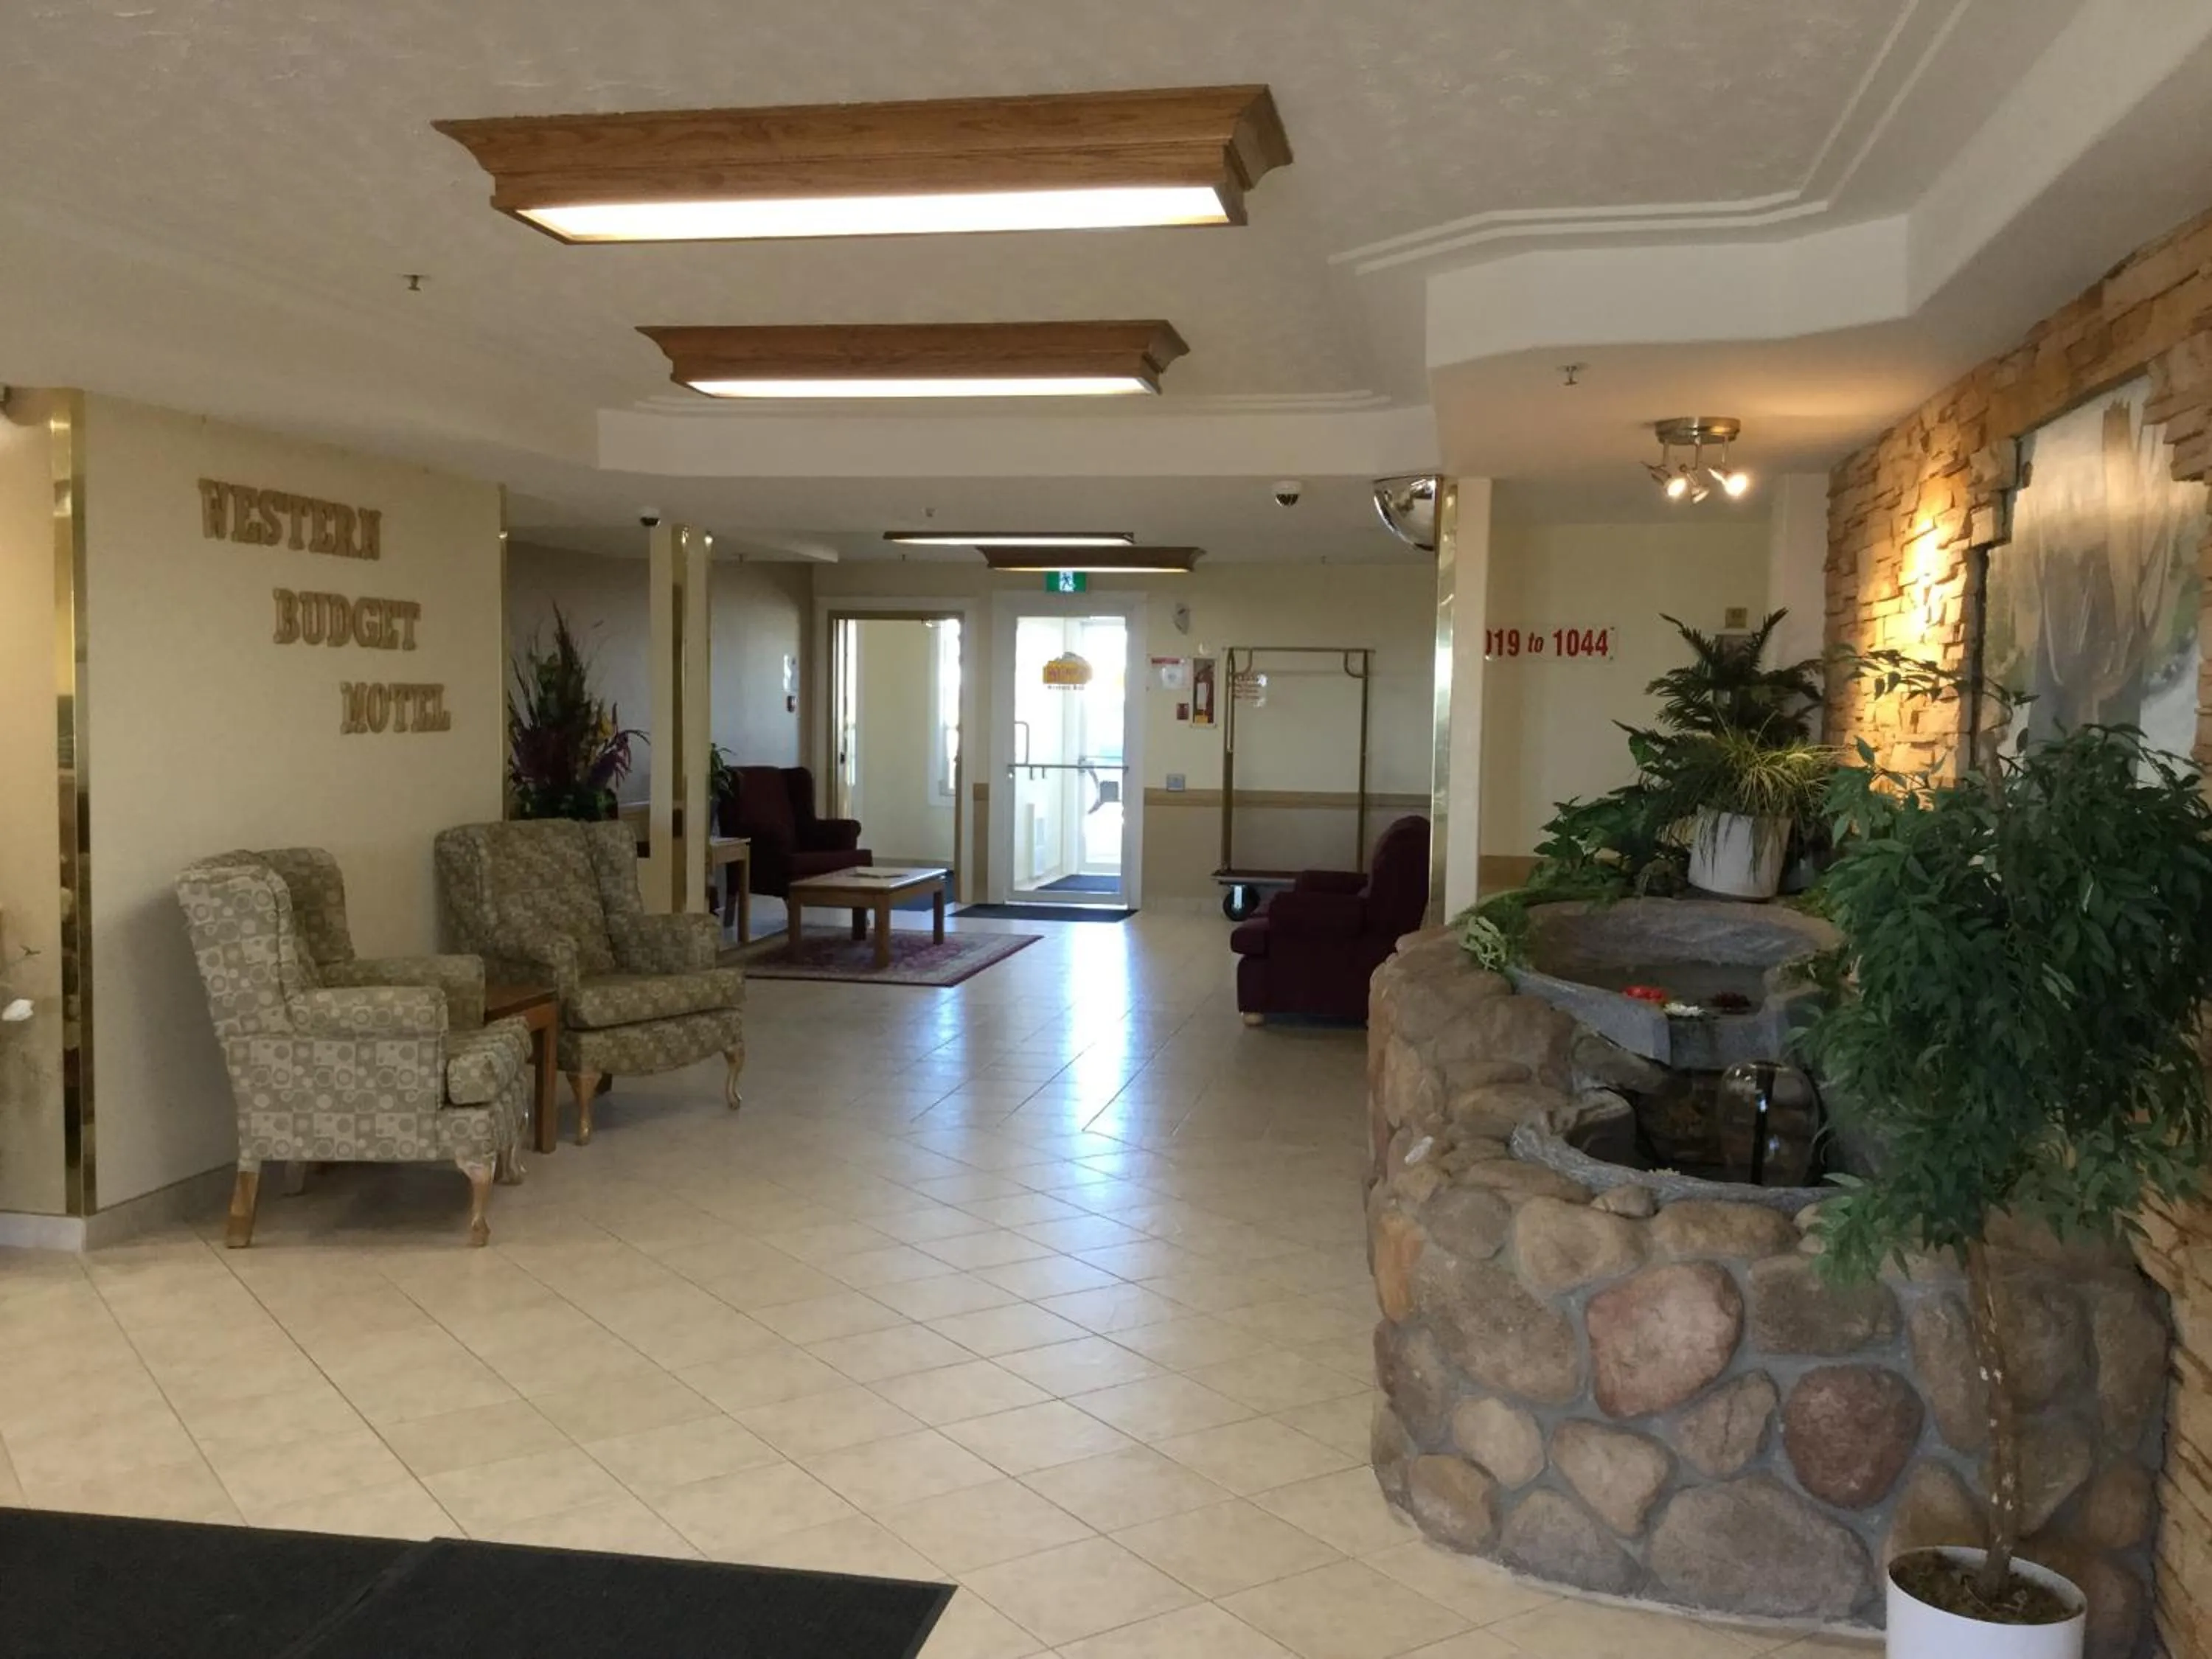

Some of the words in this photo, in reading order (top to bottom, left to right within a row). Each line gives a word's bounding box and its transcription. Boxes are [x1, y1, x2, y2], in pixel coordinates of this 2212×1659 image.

[198, 478, 382, 560] WESTERN
[272, 588, 421, 651] BUDGET
[1527, 632, 1544, 653] to
[1553, 628, 1608, 656] 1044
[340, 681, 451, 734] MOTEL
